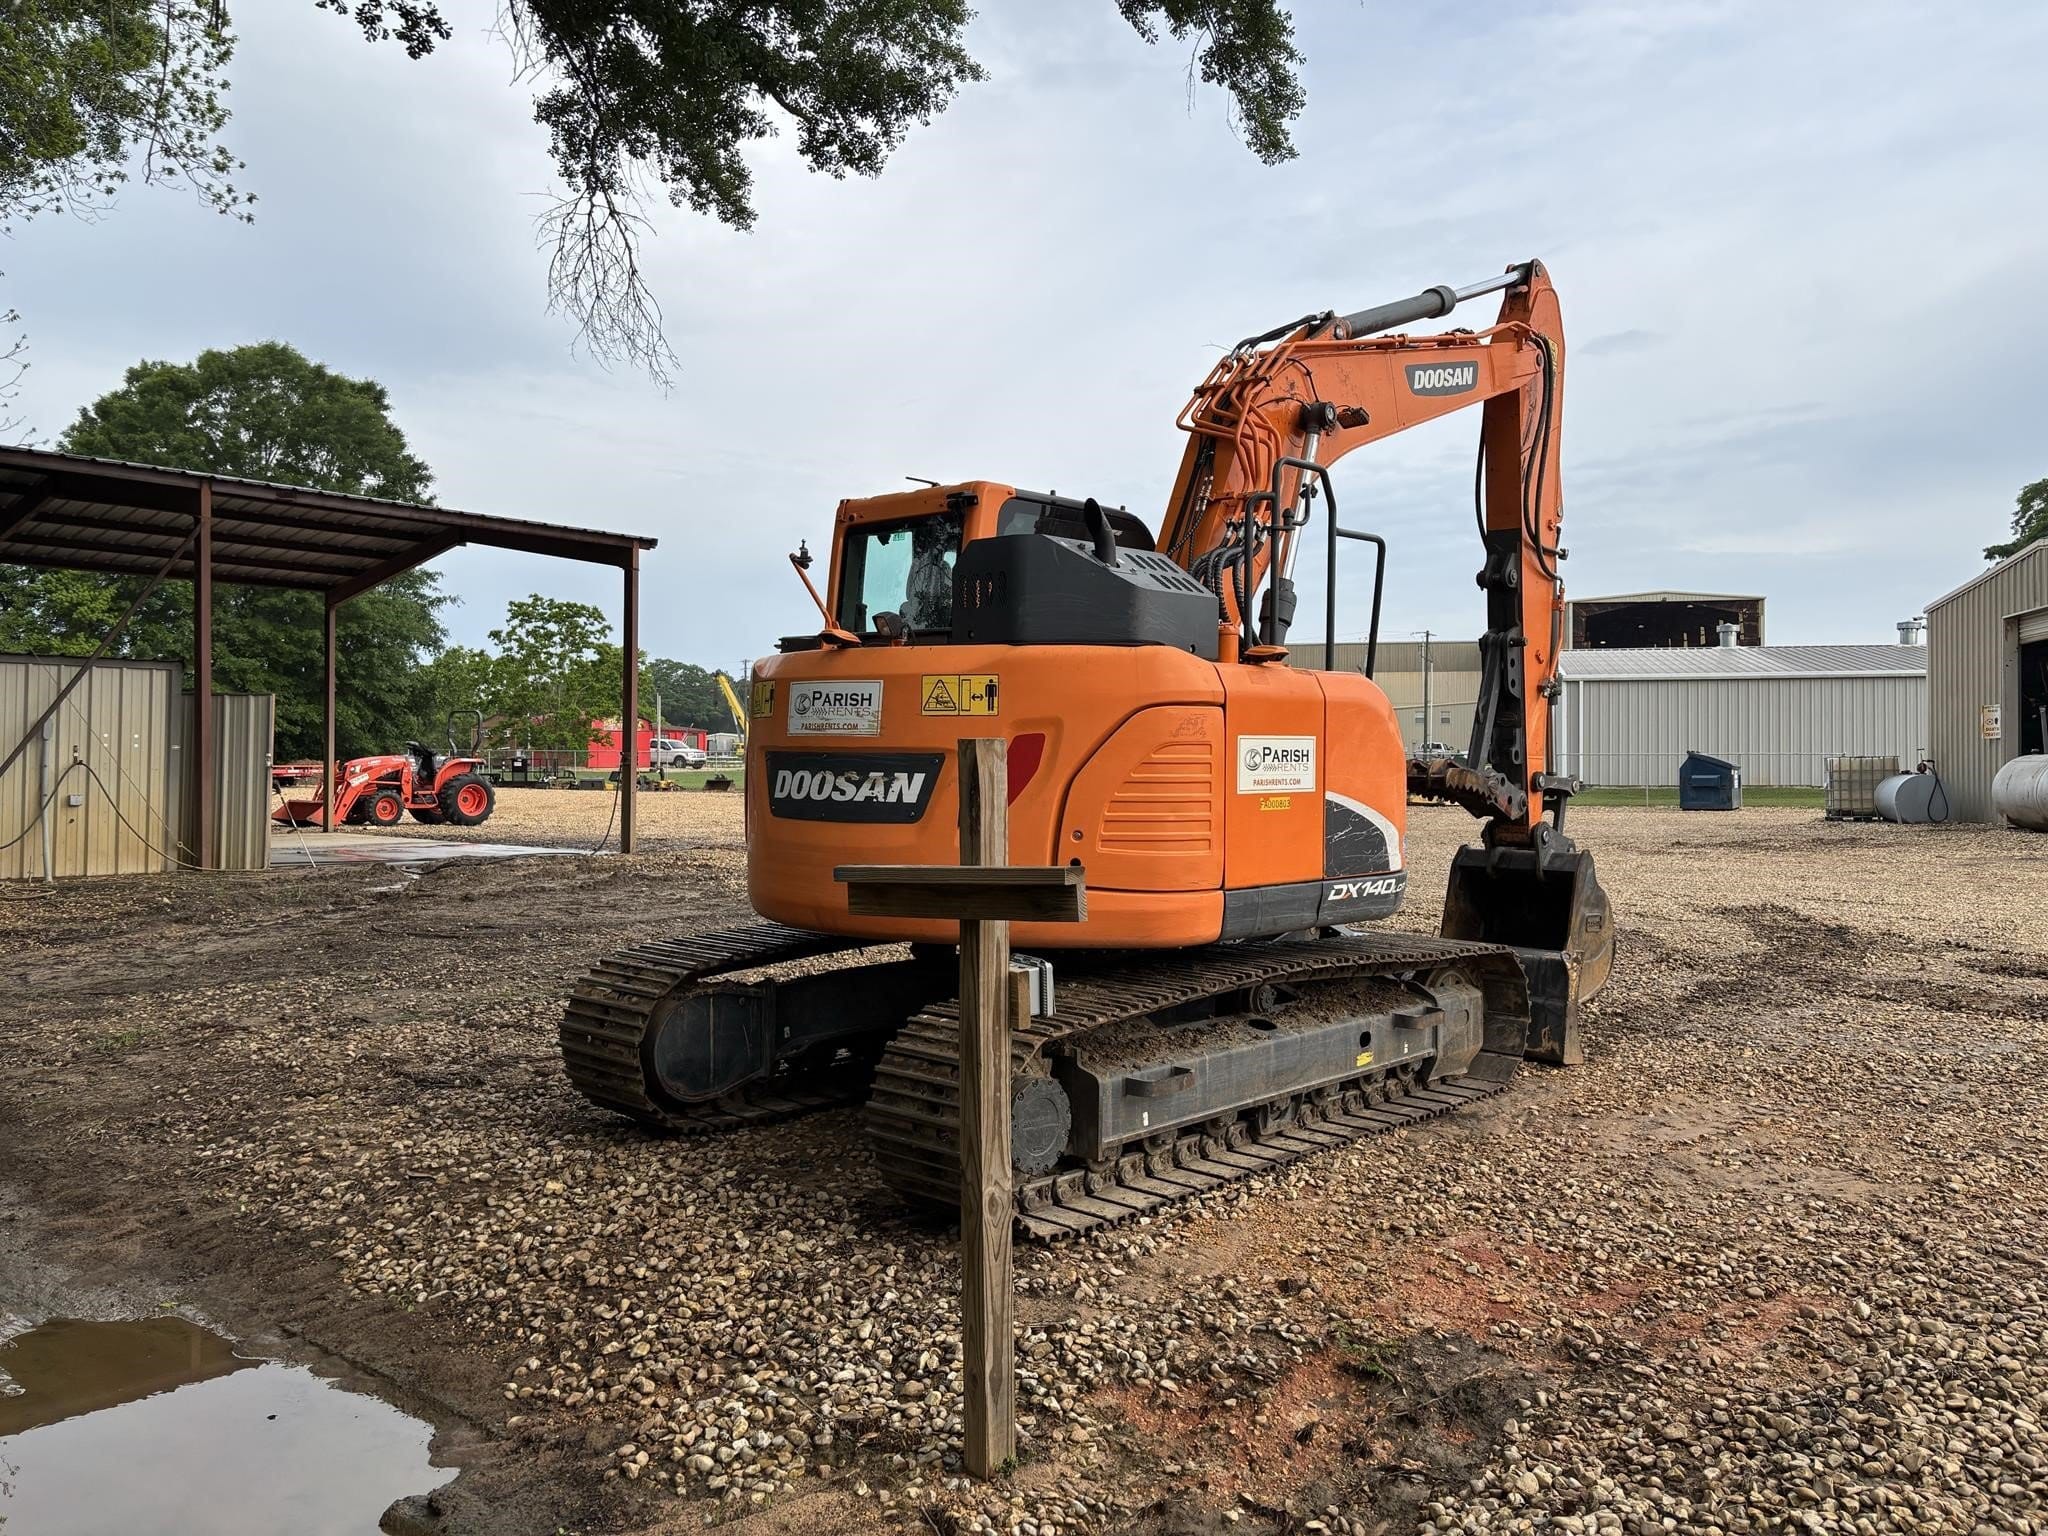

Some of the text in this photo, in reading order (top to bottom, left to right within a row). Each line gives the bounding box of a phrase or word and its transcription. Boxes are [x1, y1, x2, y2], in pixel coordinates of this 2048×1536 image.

[1414, 367, 1473, 389] DOOSAN
[812, 690, 873, 706] PARISH
[828, 706, 871, 717] RENTS
[801, 722, 859, 731] PARISHRENTS.COM
[1262, 746, 1310, 763] PARISH
[1277, 763, 1309, 772] RENTS
[774, 770, 926, 803] DOOSAN
[1253, 778, 1301, 786] PARISHRENTS.COM
